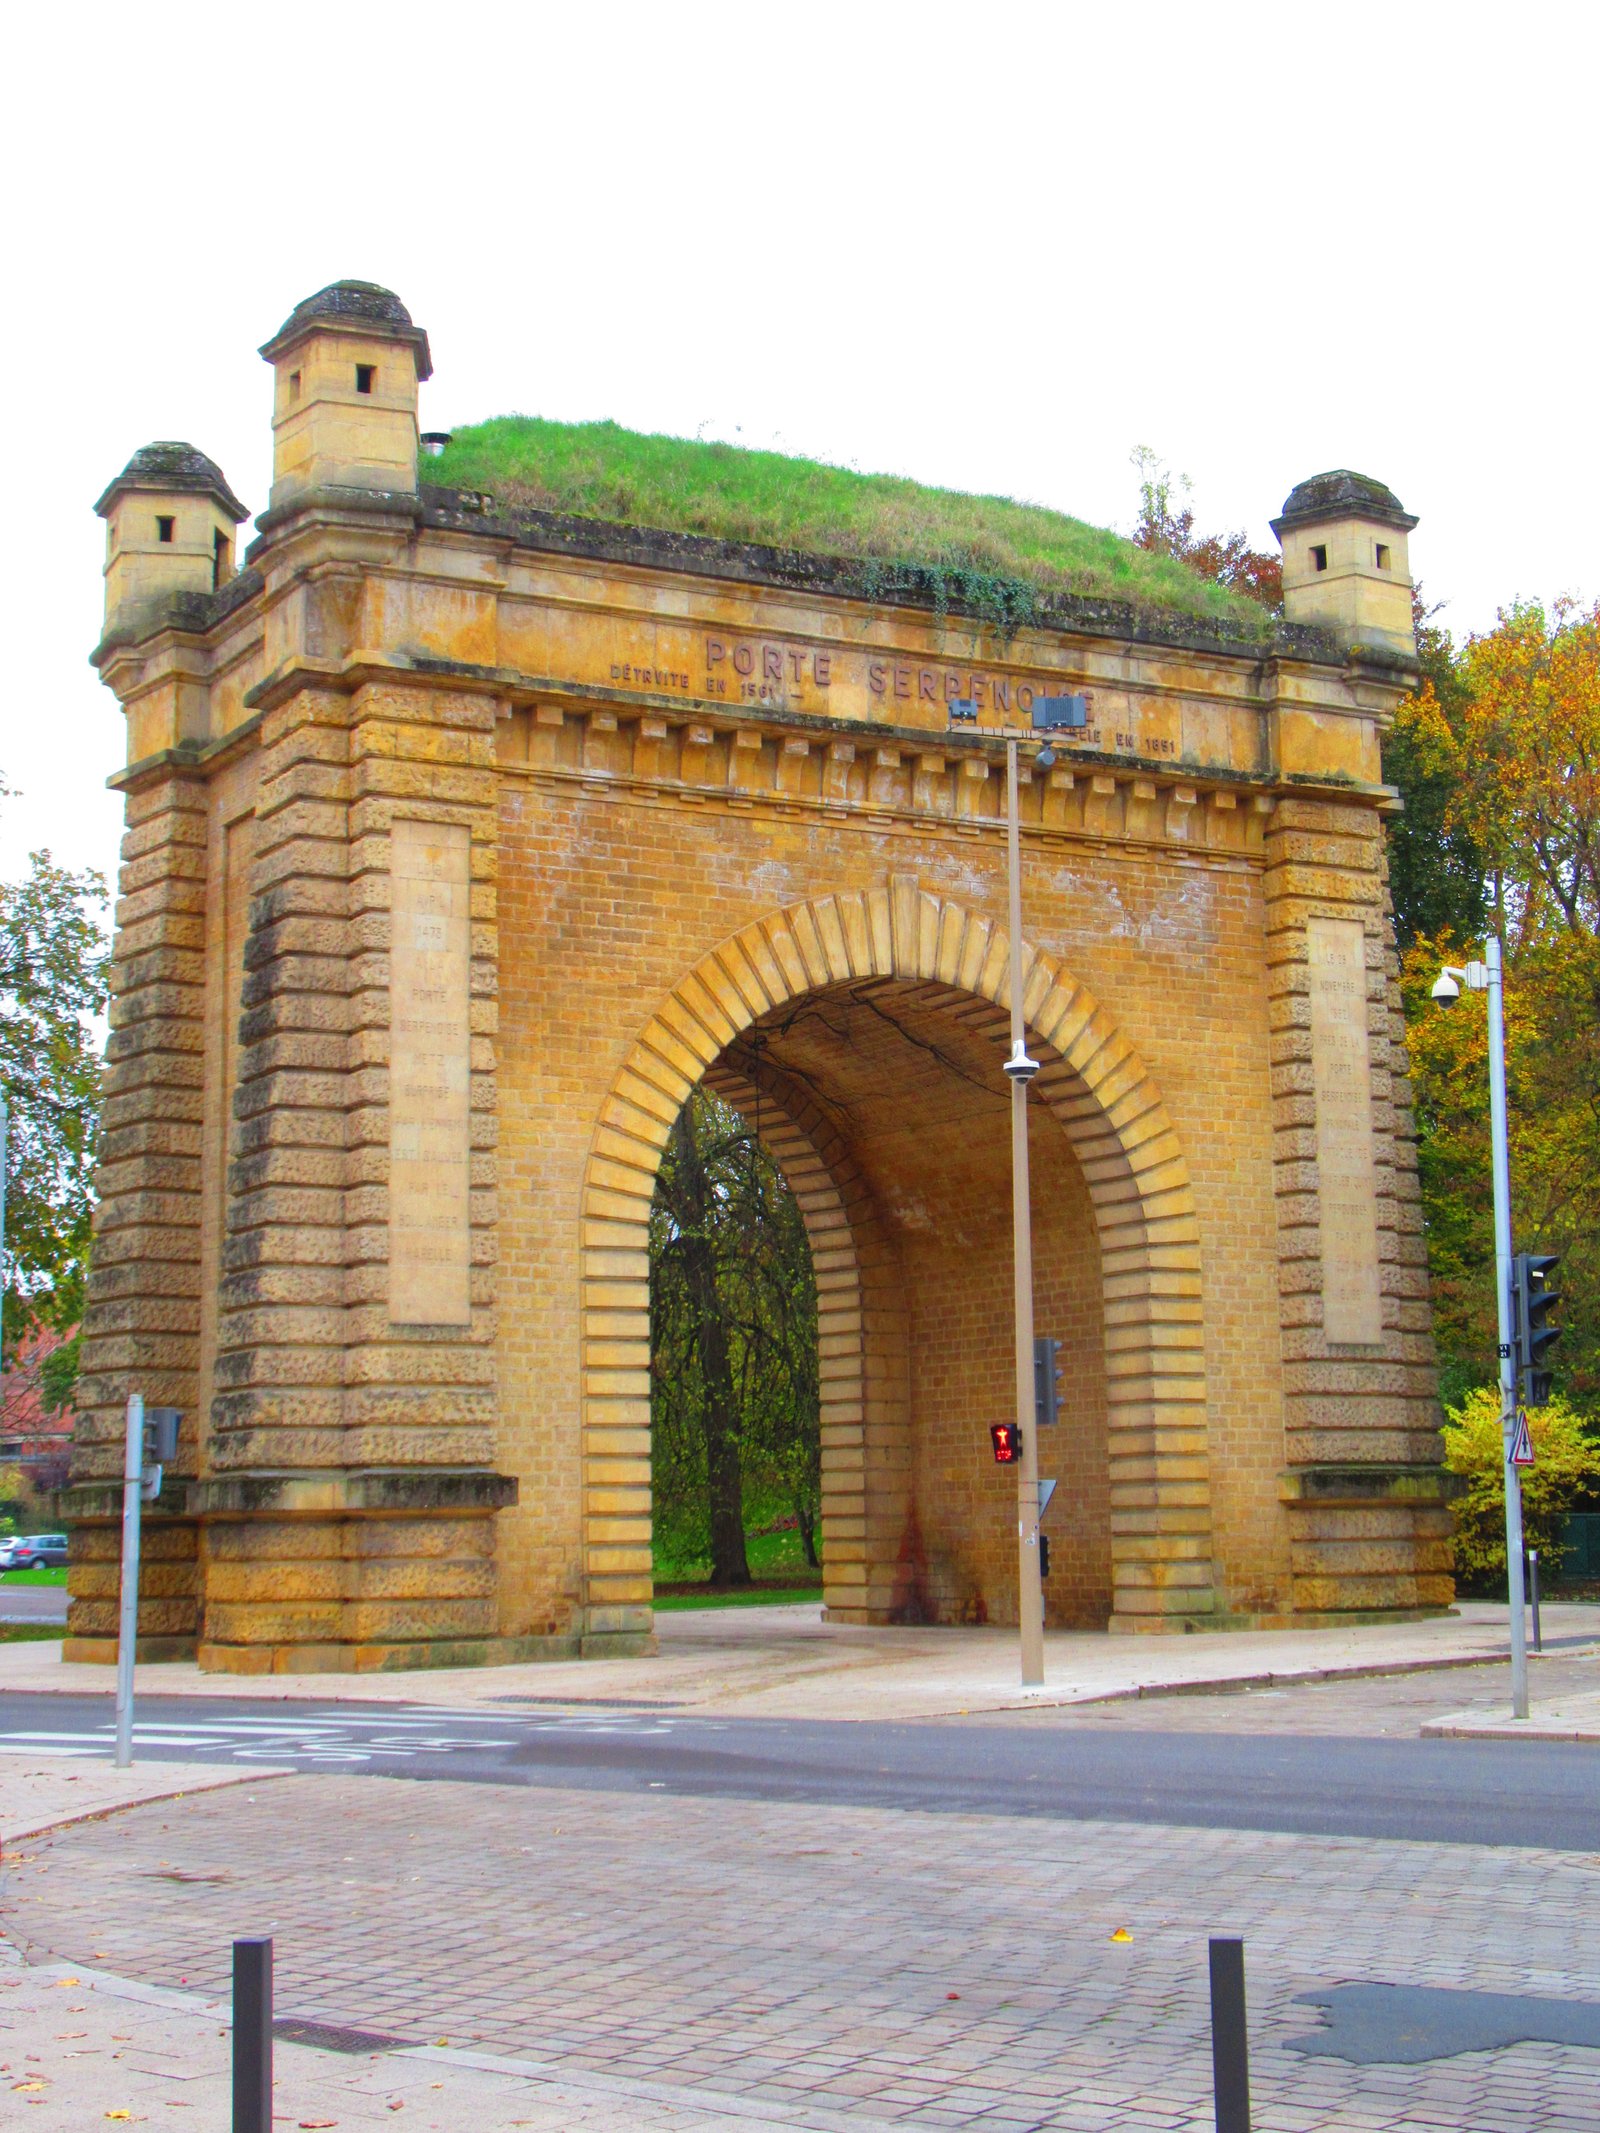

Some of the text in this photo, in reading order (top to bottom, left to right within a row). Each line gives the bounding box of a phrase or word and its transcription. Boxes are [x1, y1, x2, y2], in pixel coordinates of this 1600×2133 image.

[706, 639, 1095, 723] PORTE SERPENOE
[706, 677, 726, 693] EN
[741, 682, 774, 700] 1561
[1115, 732, 1133, 748] EN
[1146, 738, 1175, 753] 1851
[413, 987, 447, 1003] PORTE
[232, 1736, 520, 1762] BUS
